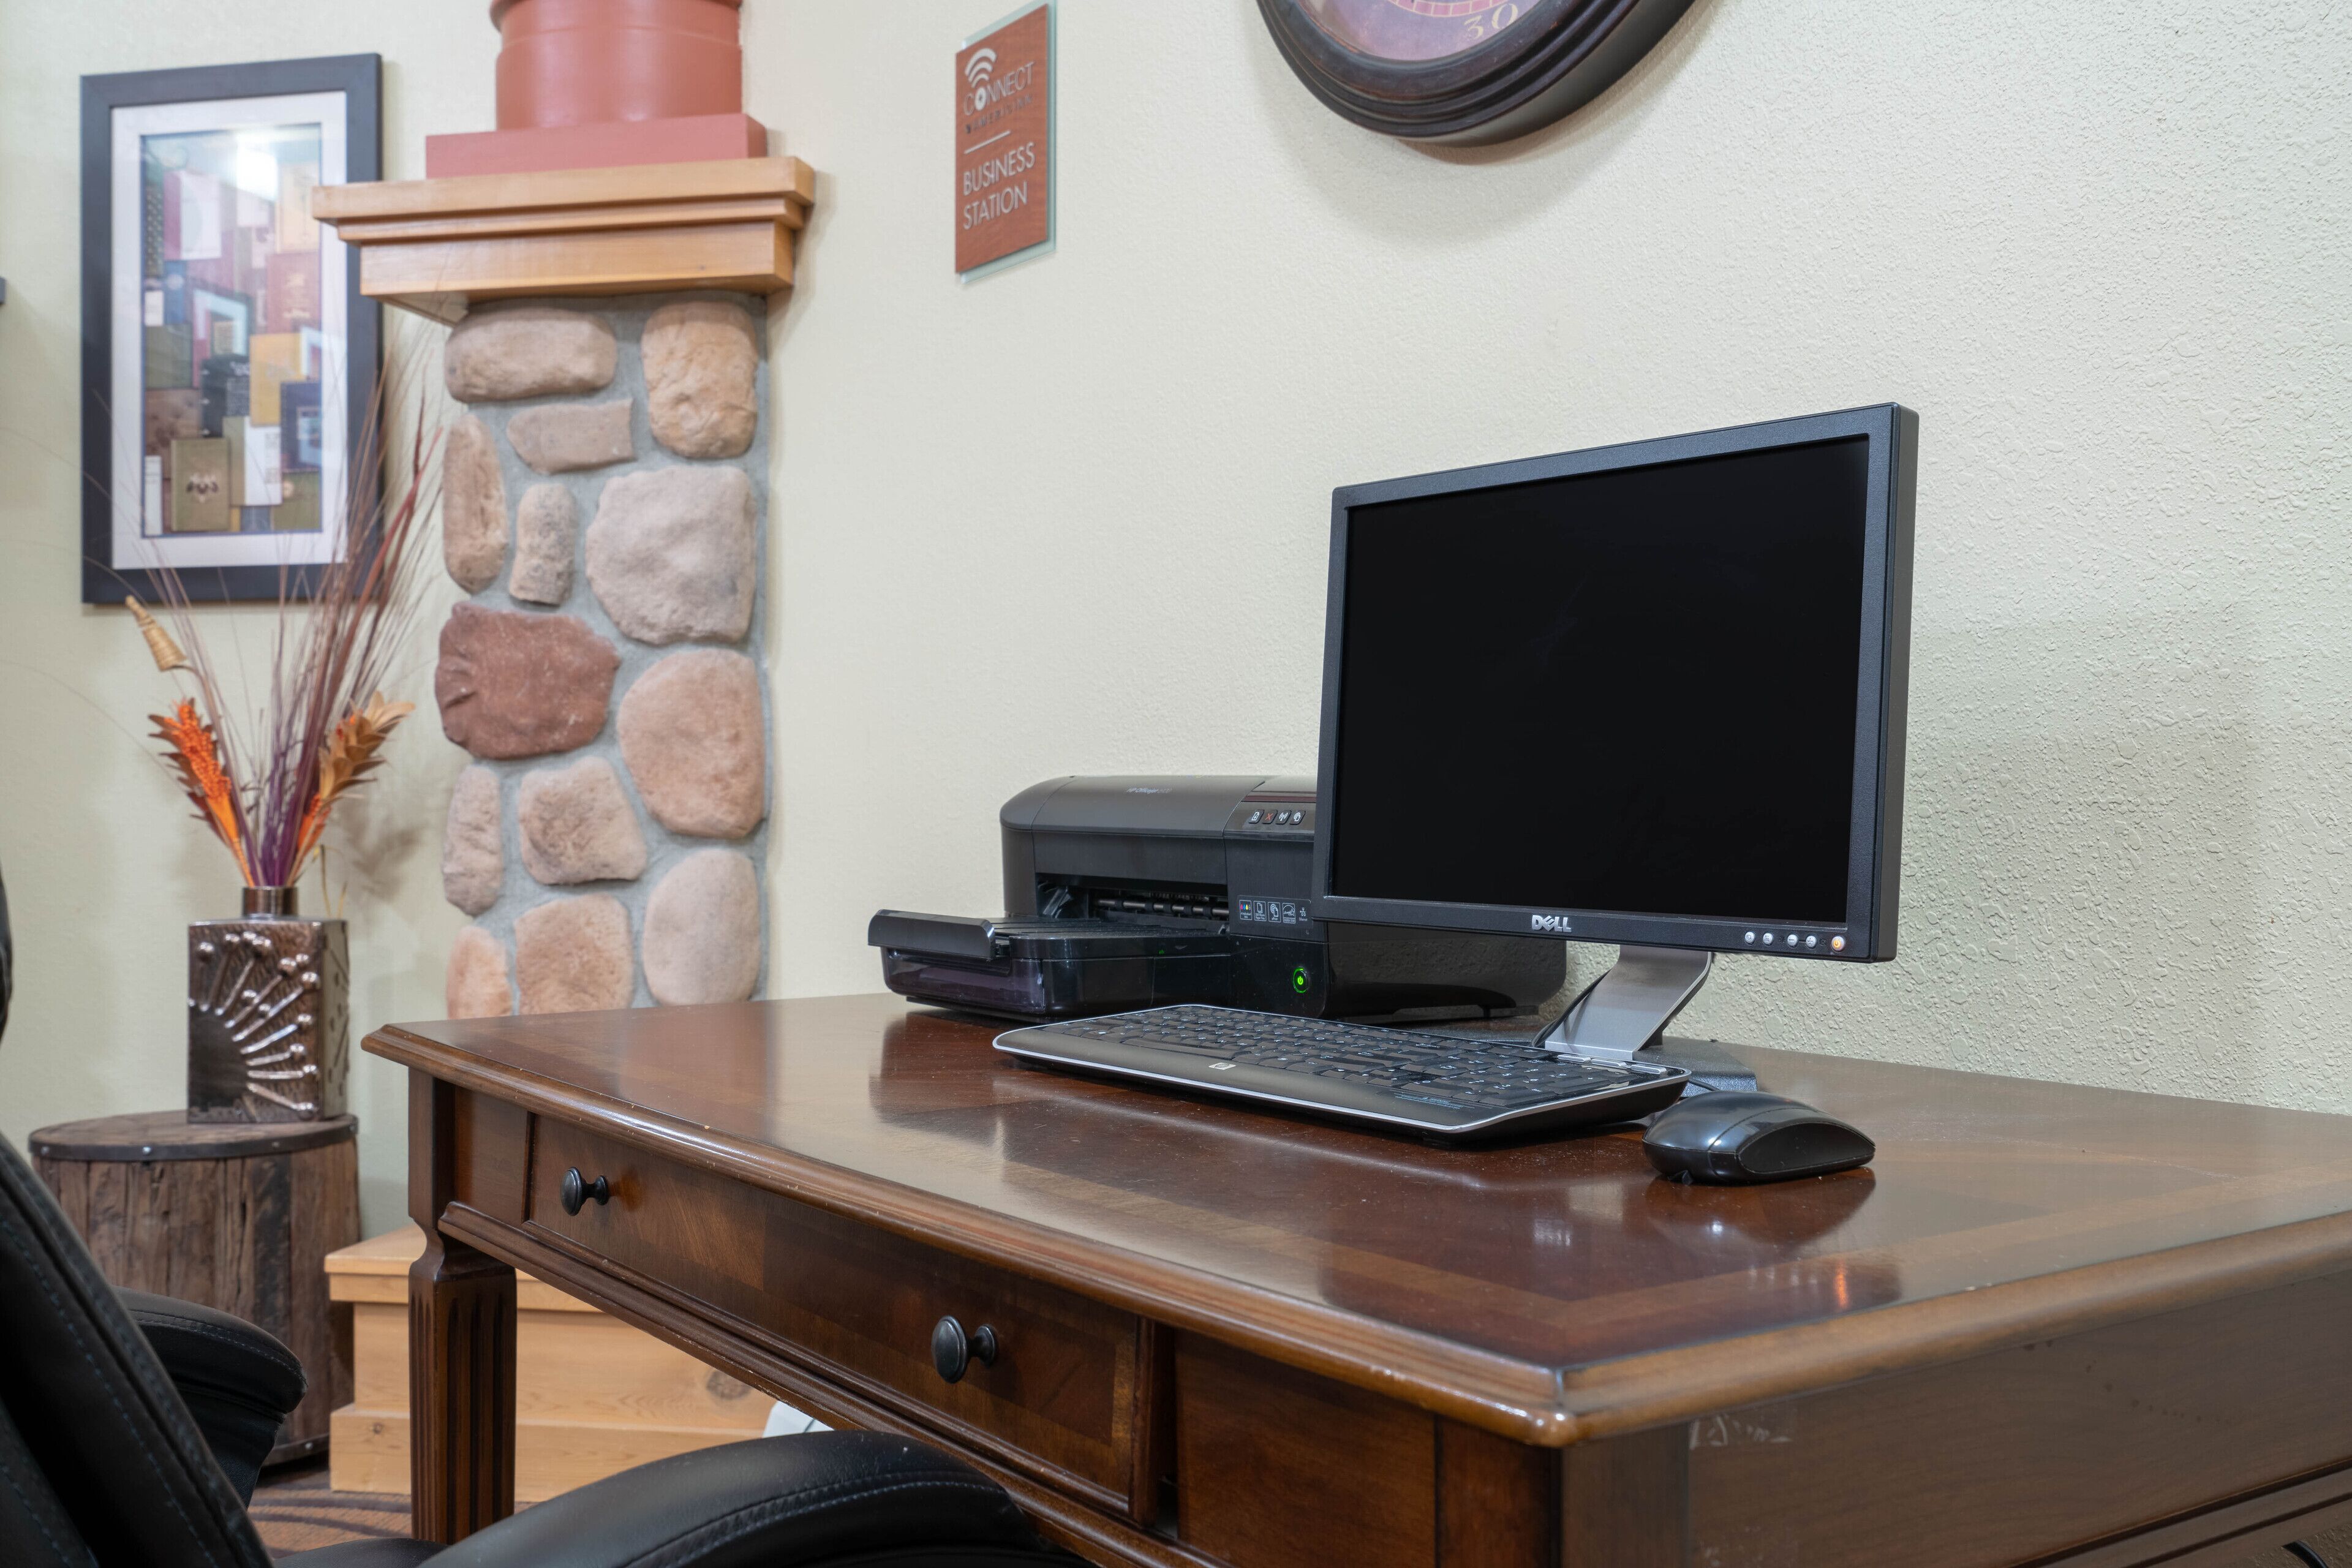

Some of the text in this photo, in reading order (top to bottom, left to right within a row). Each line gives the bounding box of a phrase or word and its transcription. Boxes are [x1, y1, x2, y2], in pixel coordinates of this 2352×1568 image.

[1463, 3, 1518, 40] 30
[963, 61, 1034, 116] CONNECT
[963, 141, 1035, 196] BUSINESS
[963, 181, 1028, 230] STATION
[1532, 914, 1572, 933] DELL
